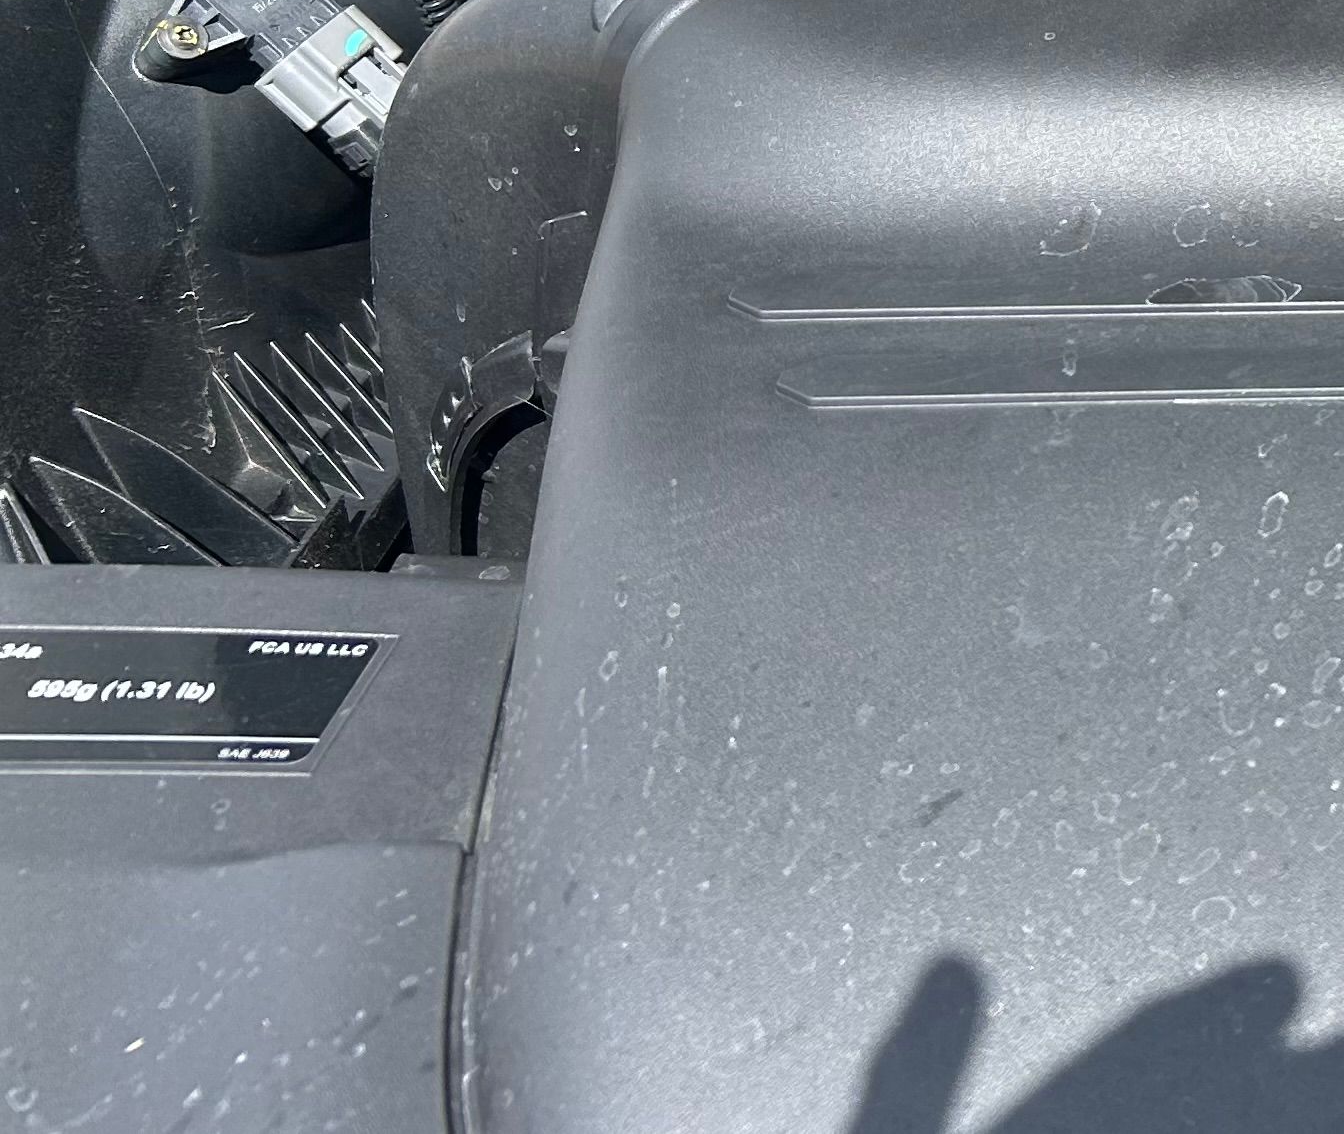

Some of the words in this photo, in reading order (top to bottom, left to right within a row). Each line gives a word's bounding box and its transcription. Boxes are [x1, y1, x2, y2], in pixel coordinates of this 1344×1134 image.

[248, 640, 290, 655] FCA
[294, 642, 325, 656] US
[326, 643, 369, 657] LLC
[27, 679, 98, 702] 595g
[100, 679, 172, 702] (1.31
[175, 681, 216, 704] lb)
[217, 747, 252, 759] SAE
